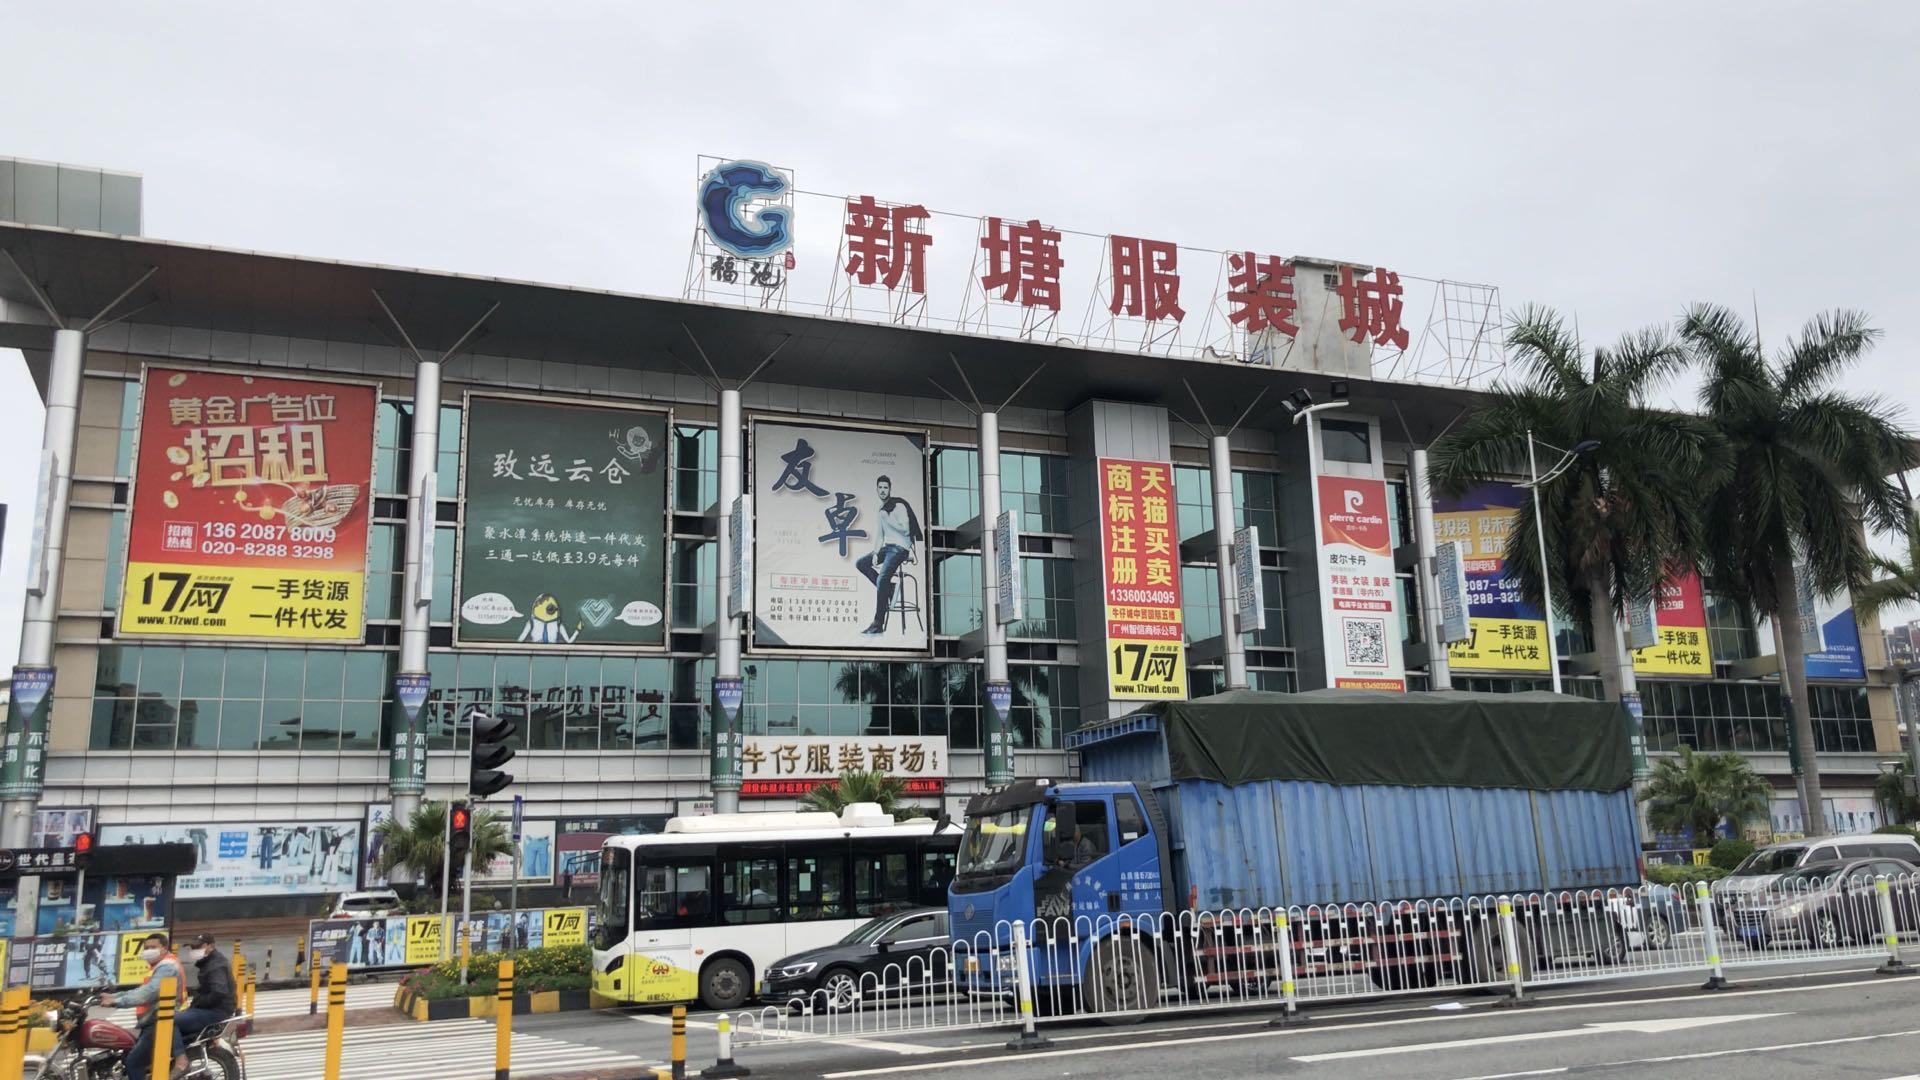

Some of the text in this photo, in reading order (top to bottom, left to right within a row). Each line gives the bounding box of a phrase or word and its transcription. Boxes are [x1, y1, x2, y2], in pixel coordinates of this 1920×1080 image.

[845, 195, 1409, 352] 新塘服装城
[169, 393, 336, 425] 黄金广告位
[184, 424, 328, 487] 招租
[492, 450, 631, 485] 致远云仓
[1107, 464, 1138, 585] 商标注册
[1140, 467, 1172, 586] 天猫买卖
[1329, 514, 1382, 524] pierre cardin
[168, 525, 193, 538] 招商
[203, 522, 336, 543] 136 2087 8009
[166, 537, 193, 549] 热线
[202, 542, 334, 559] 020-8288 3298
[485, 549, 640, 567] 三通一达低至3.9元每件
[1330, 554, 1366, 566] 皮尔卡丹
[142, 571, 232, 613] 17网
[252, 579, 350, 601] 一手货源
[1110, 589, 1175, 604] 13360034095
[137, 614, 226, 627] www.17zwd.com
[249, 607, 348, 629] 一件代发
[1487, 626, 1537, 640] 一手货源
[1114, 644, 1178, 681] 17网
[1489, 647, 1539, 660] 一件代发
[1655, 653, 1702, 666] 一件代发
[743, 741, 926, 774] 牛仔服装商场
